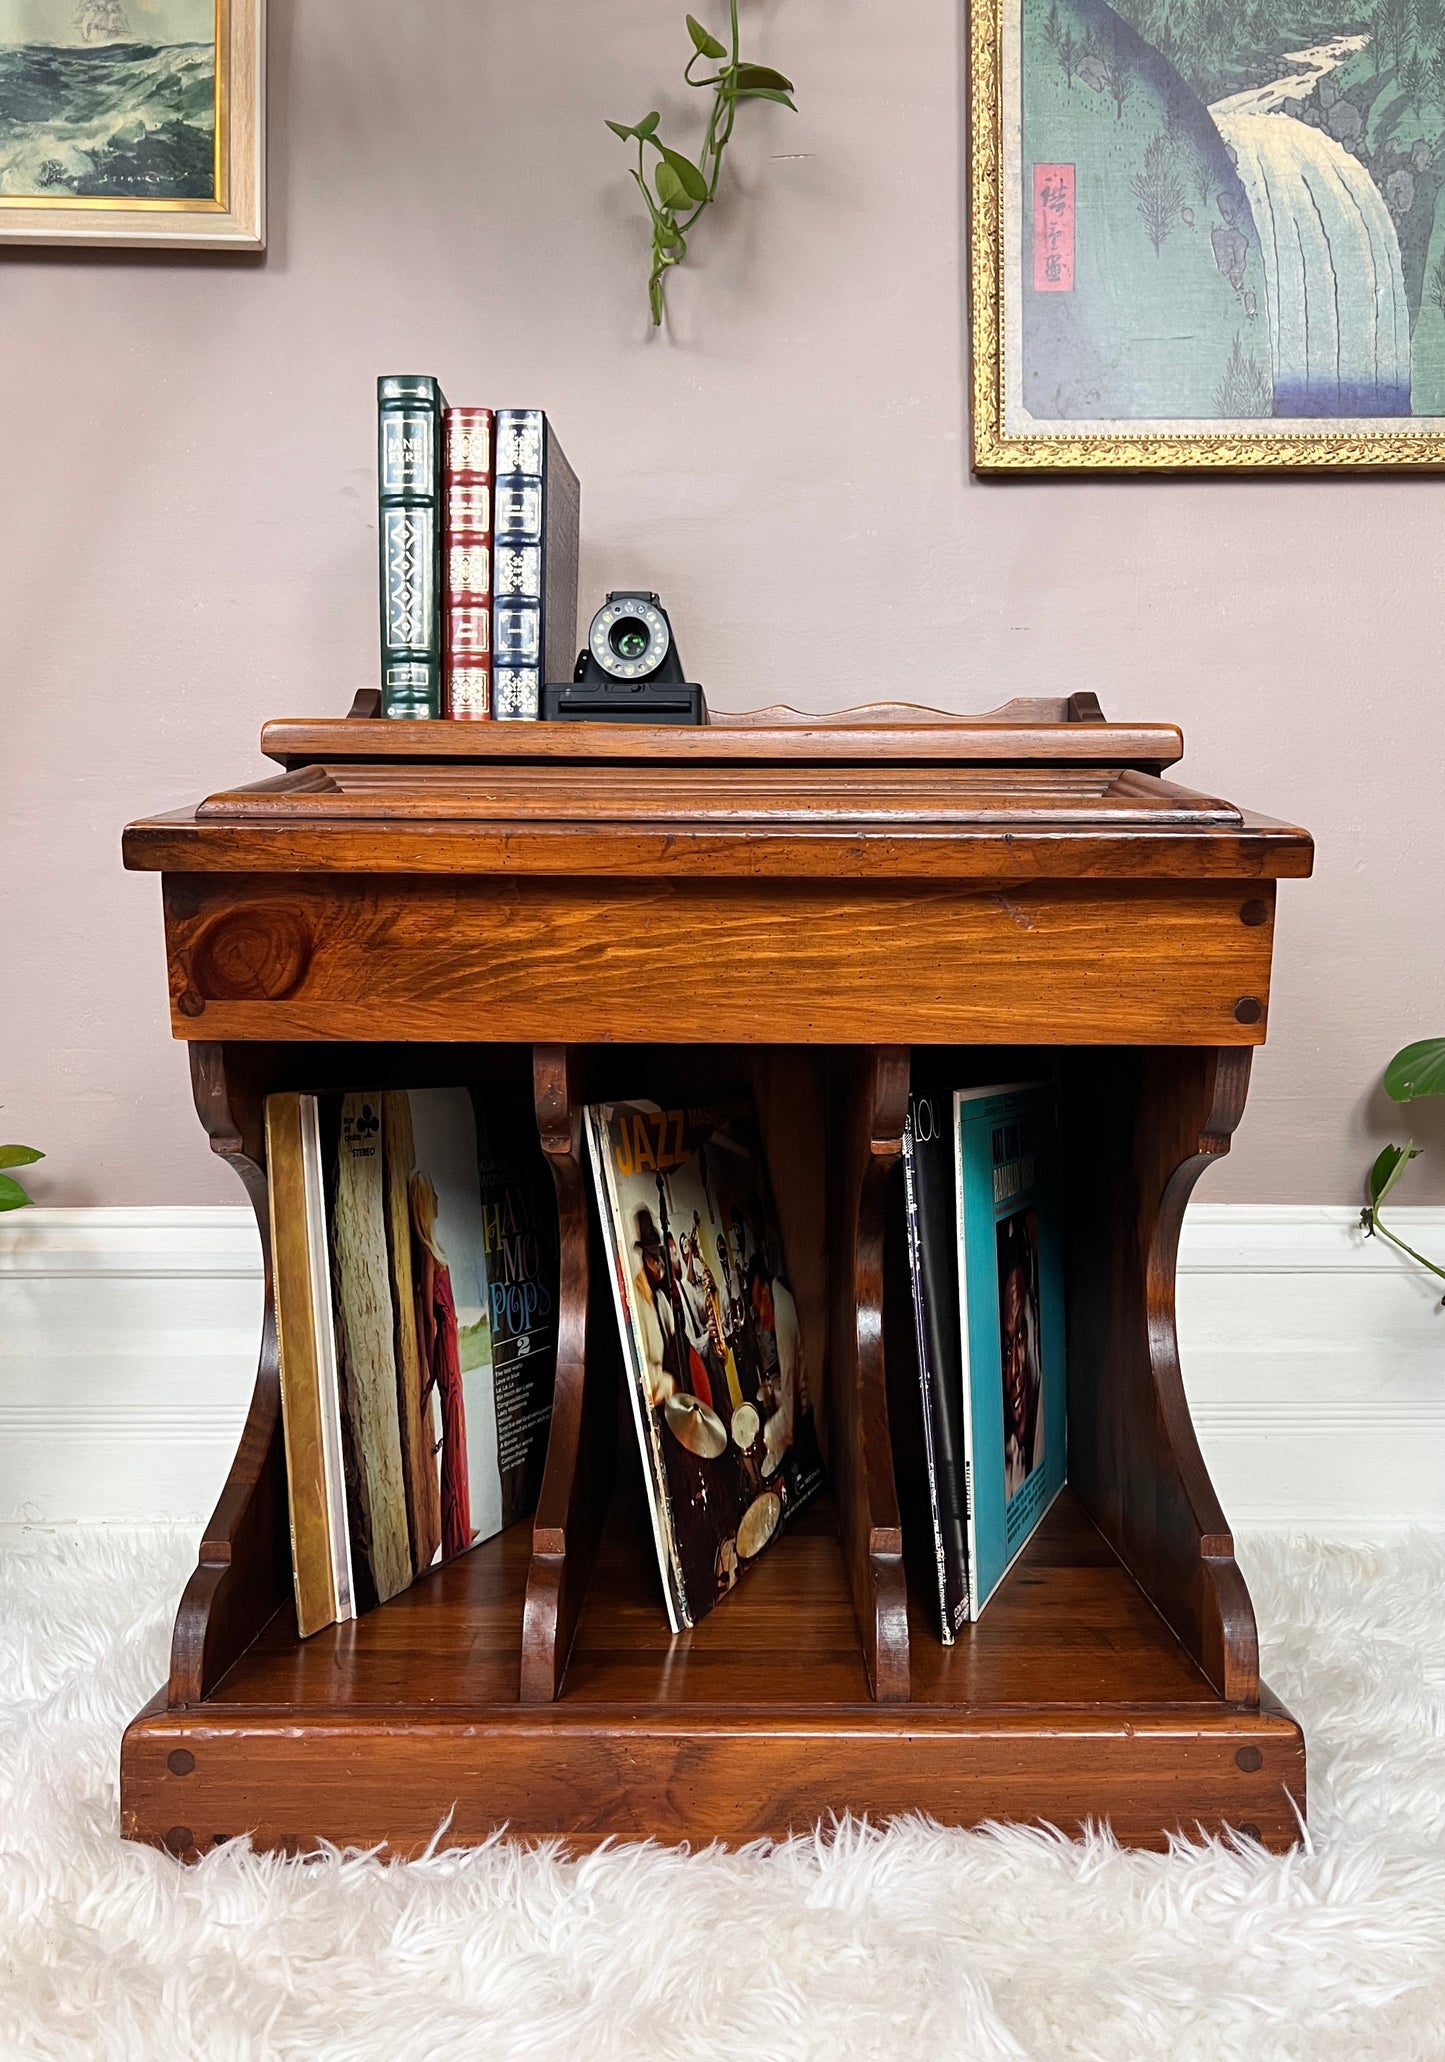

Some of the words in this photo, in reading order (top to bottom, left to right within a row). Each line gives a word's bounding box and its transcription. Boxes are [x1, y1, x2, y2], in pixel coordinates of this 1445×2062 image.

[388, 438, 423, 451] JANE
[388, 451, 423, 464] EYRE
[352, 1147, 375, 1157] STEREO
[616, 1108, 691, 1176] JAZZ
[489, 1268, 551, 1335] POPS
[516, 1336, 531, 1356] 2
[934, 1519, 945, 1562] PHILADELPHIA
[937, 1563, 946, 1609] INTERNATIONAL
